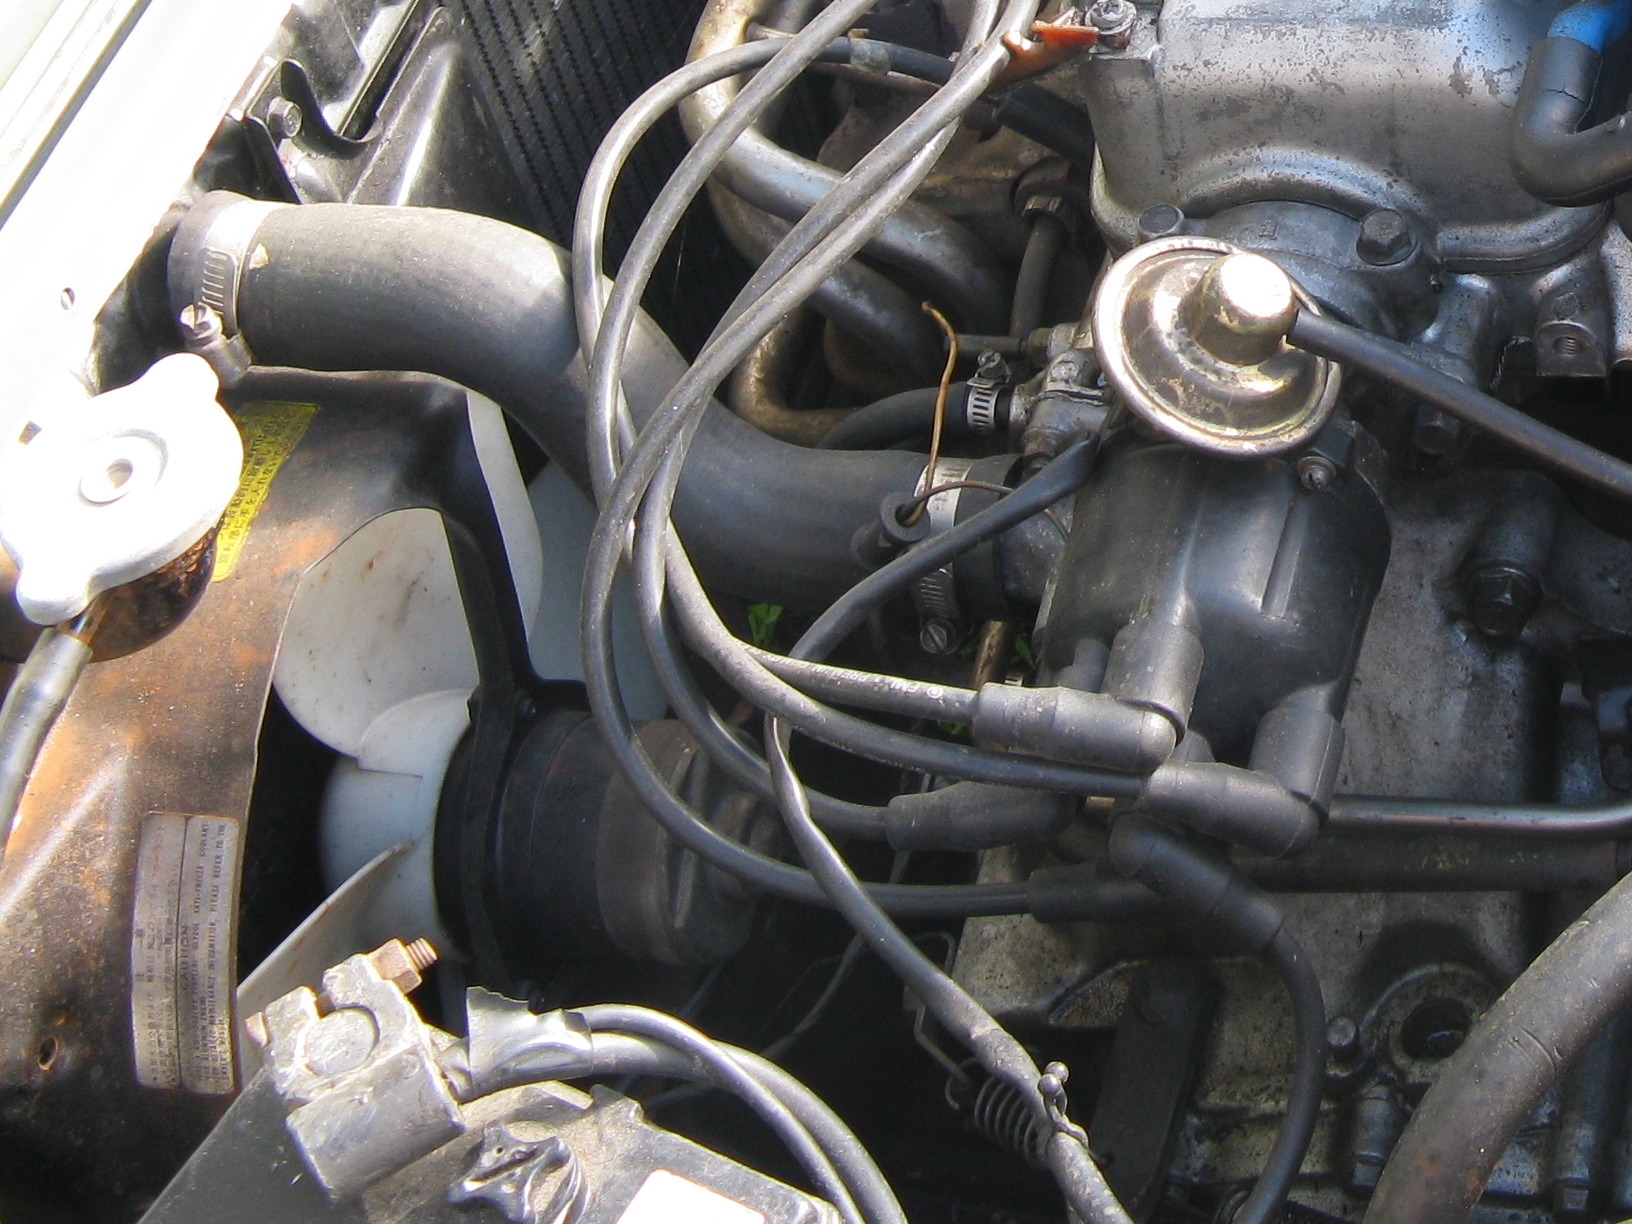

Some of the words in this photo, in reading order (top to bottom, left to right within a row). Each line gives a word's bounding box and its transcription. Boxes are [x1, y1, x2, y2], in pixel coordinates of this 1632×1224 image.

[198, 823, 209, 857] COOLANT
[213, 855, 223, 879] REFER
[193, 865, 204, 914] ANTI-FREEZE
[210, 884, 219, 912] PLEASE
[181, 925, 189, 989] CAUTION
